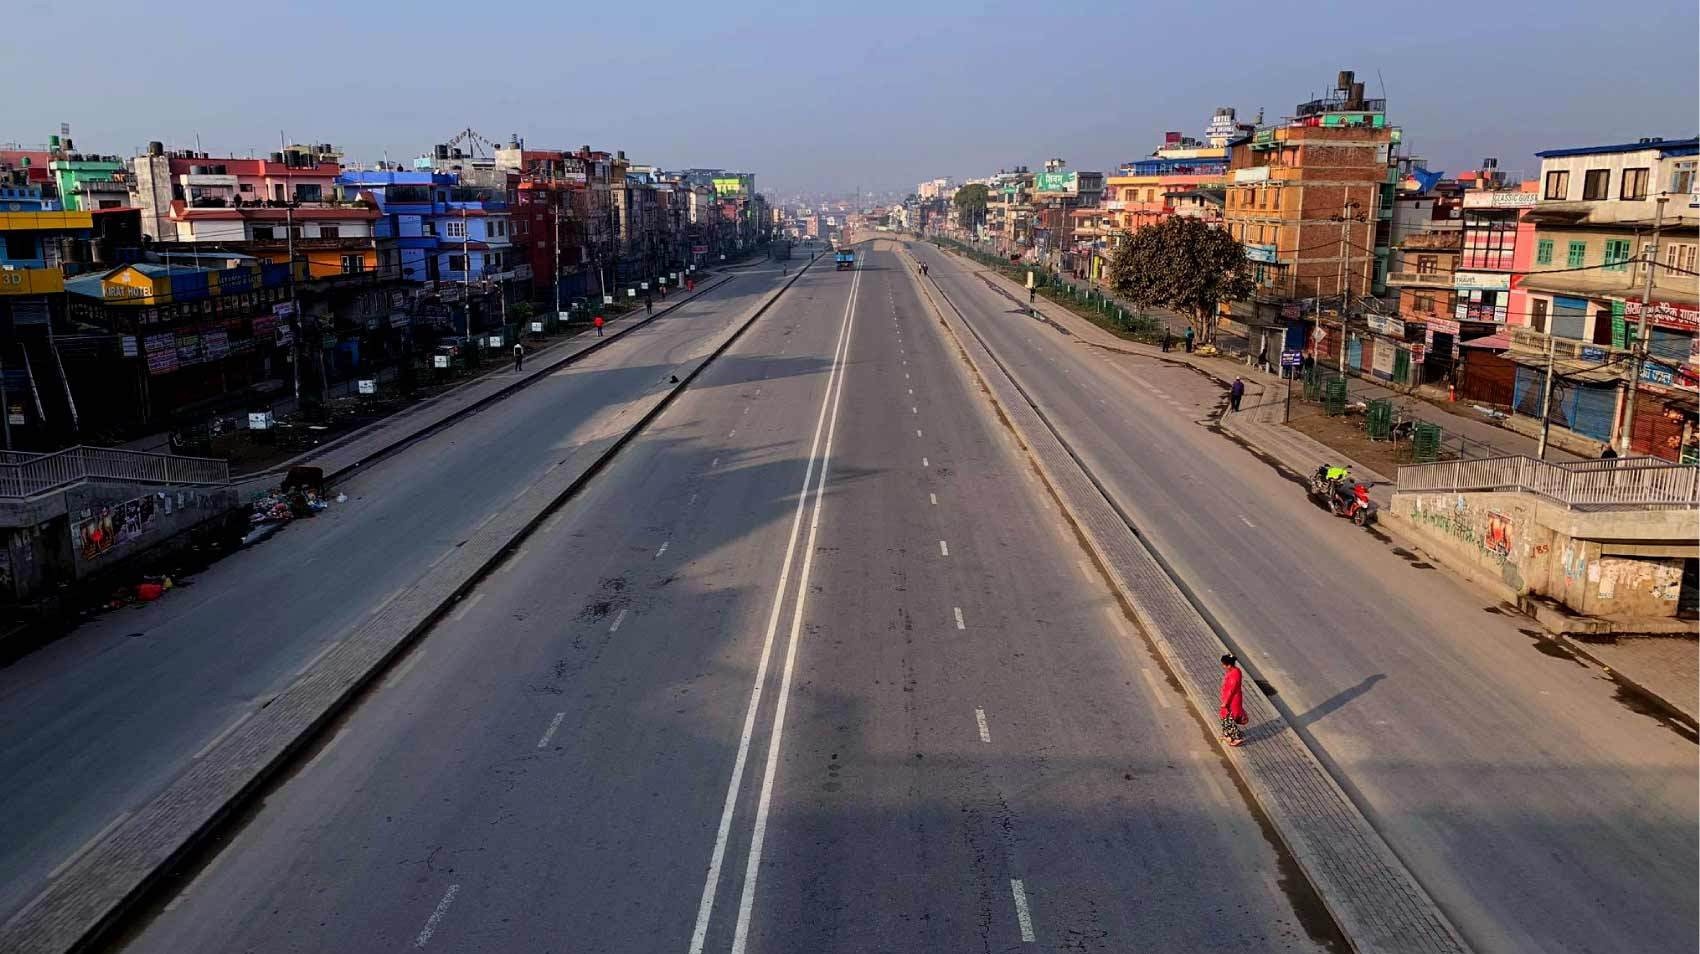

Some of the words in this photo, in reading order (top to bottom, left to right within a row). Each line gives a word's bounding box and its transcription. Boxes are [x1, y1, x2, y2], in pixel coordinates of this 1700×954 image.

[1495, 193, 1518, 202] CLASSIC
[2, 273, 22, 285] 3D
[128, 285, 153, 297] HOTEL
